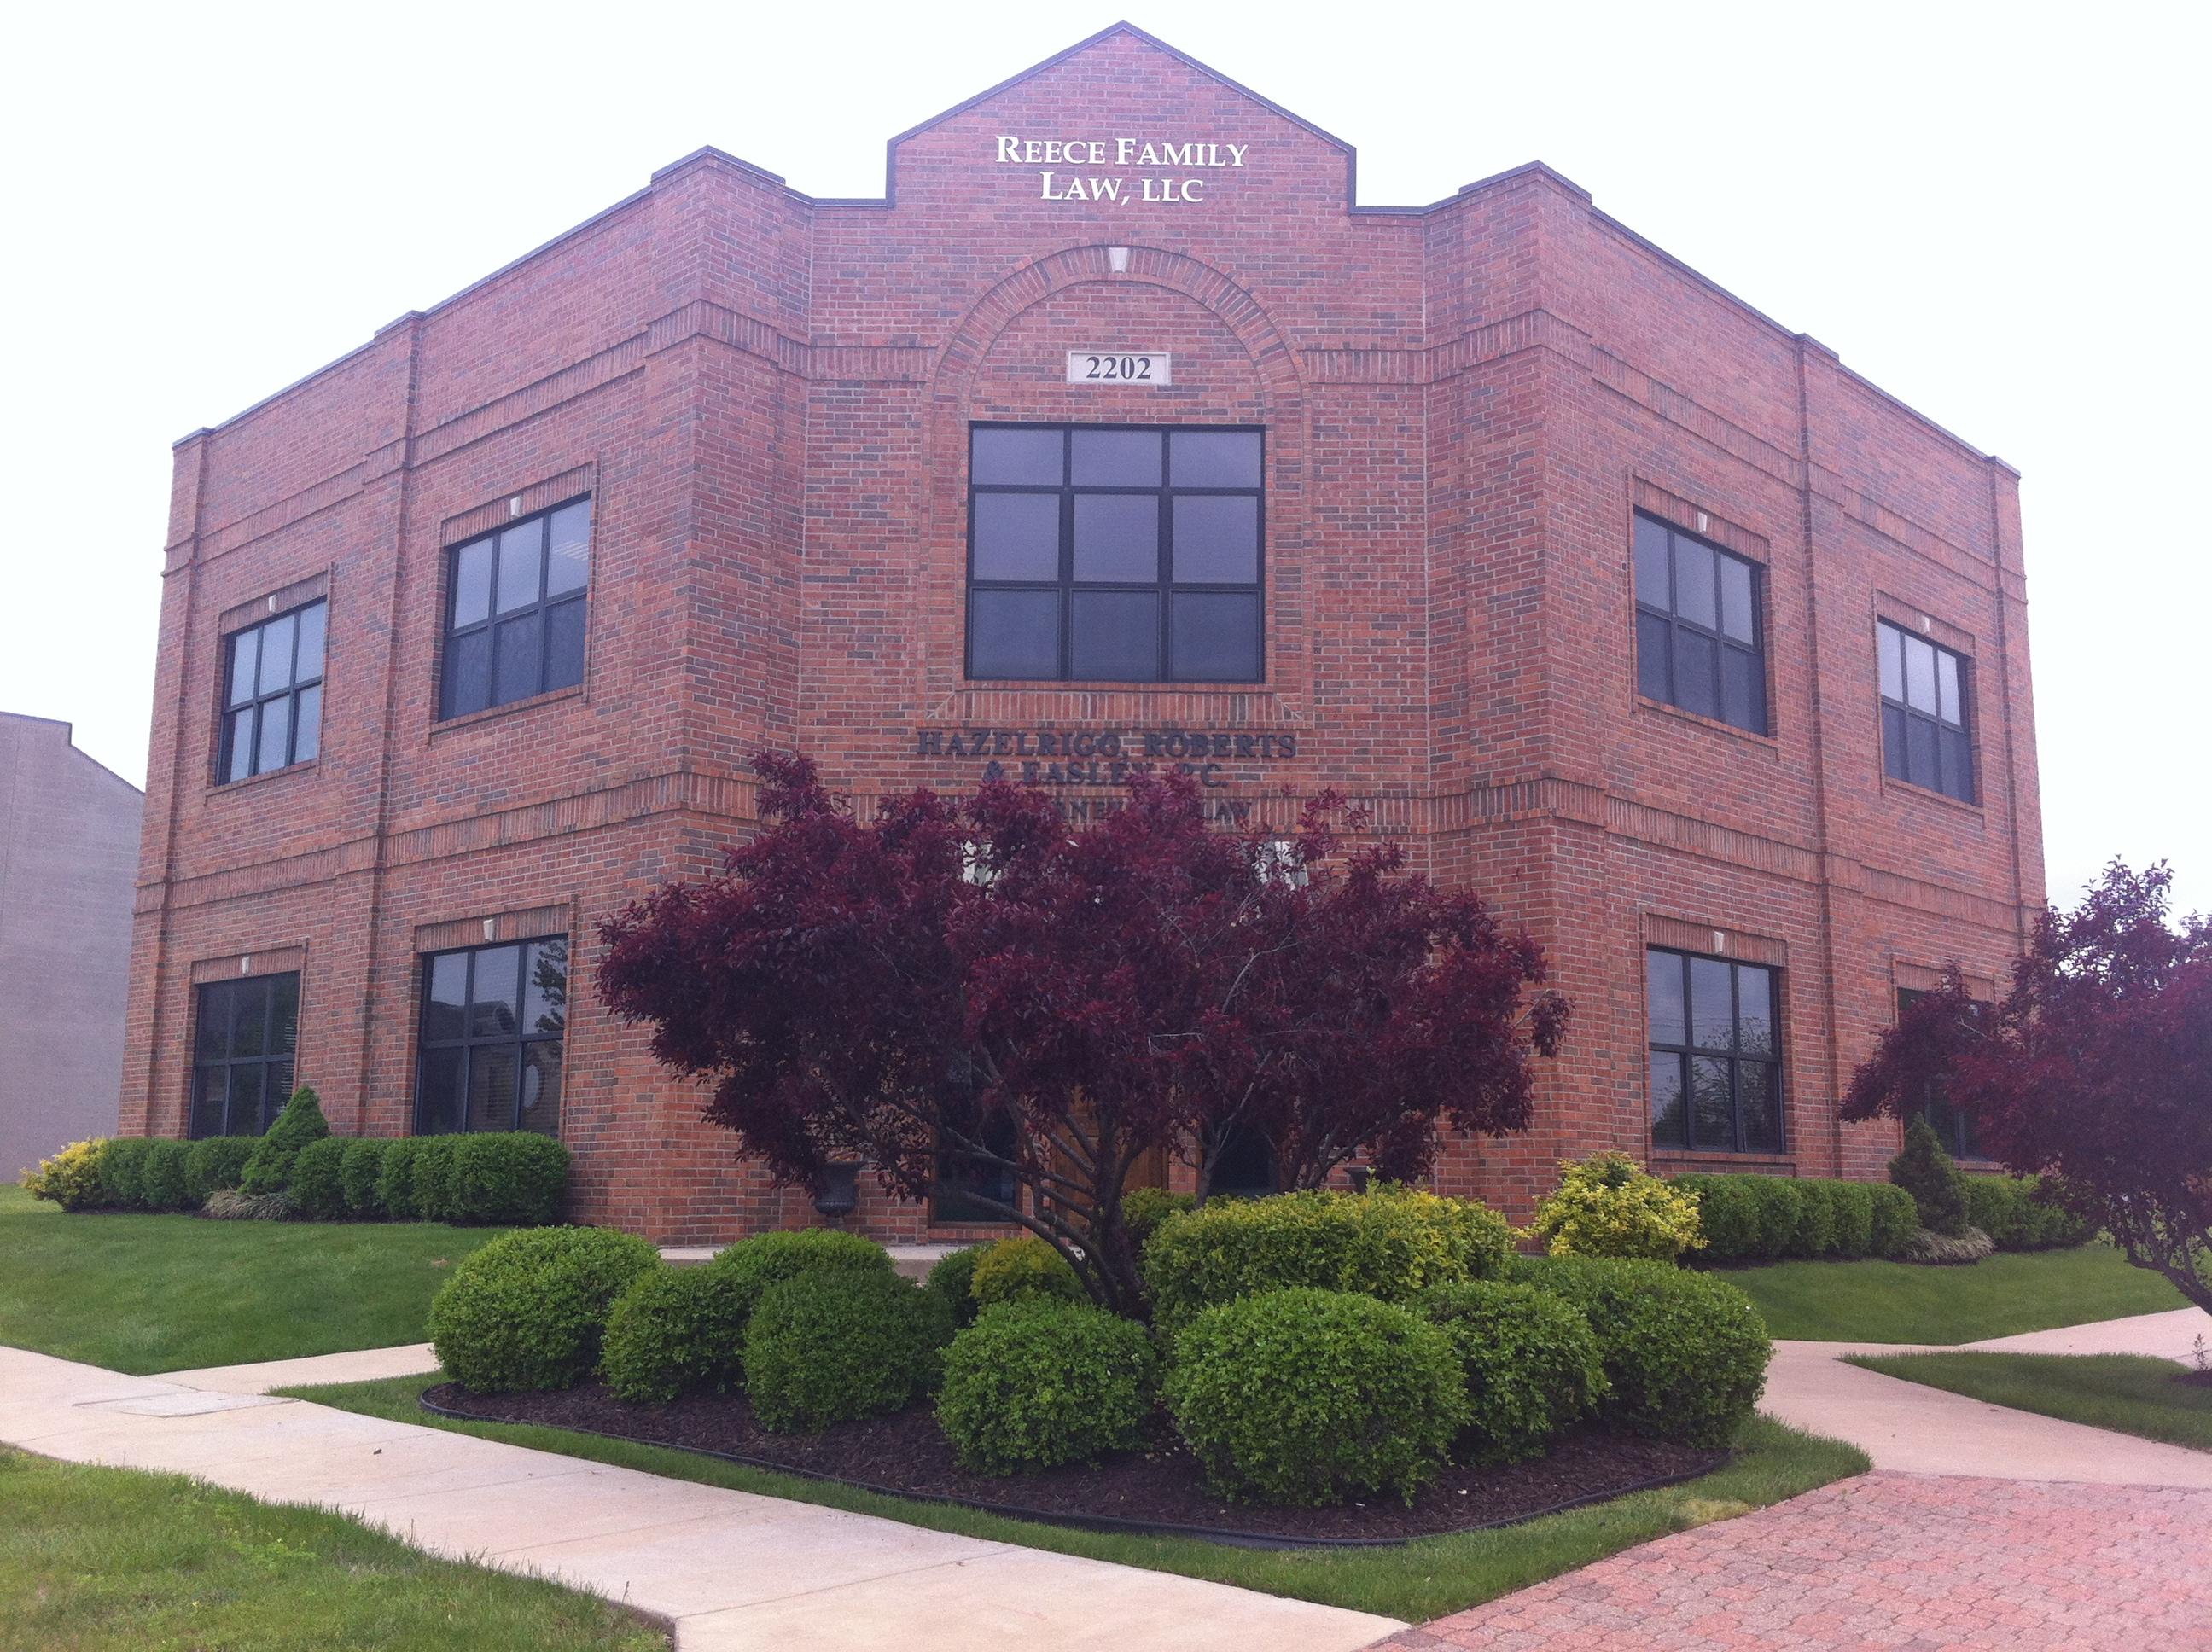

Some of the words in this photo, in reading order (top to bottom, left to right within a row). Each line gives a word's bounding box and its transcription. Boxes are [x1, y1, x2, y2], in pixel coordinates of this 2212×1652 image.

[995, 135, 1106, 165] REECE
[1115, 137, 1249, 167] FAMILY
[1039, 171, 1131, 206] LAW,
[1141, 178, 1204, 203] LLC
[1086, 356, 1151, 380] 2202
[917, 730, 1129, 760] HAZELRIGG,
[1144, 733, 1297, 758] ROBERTS
[982, 760, 1004, 782] &
